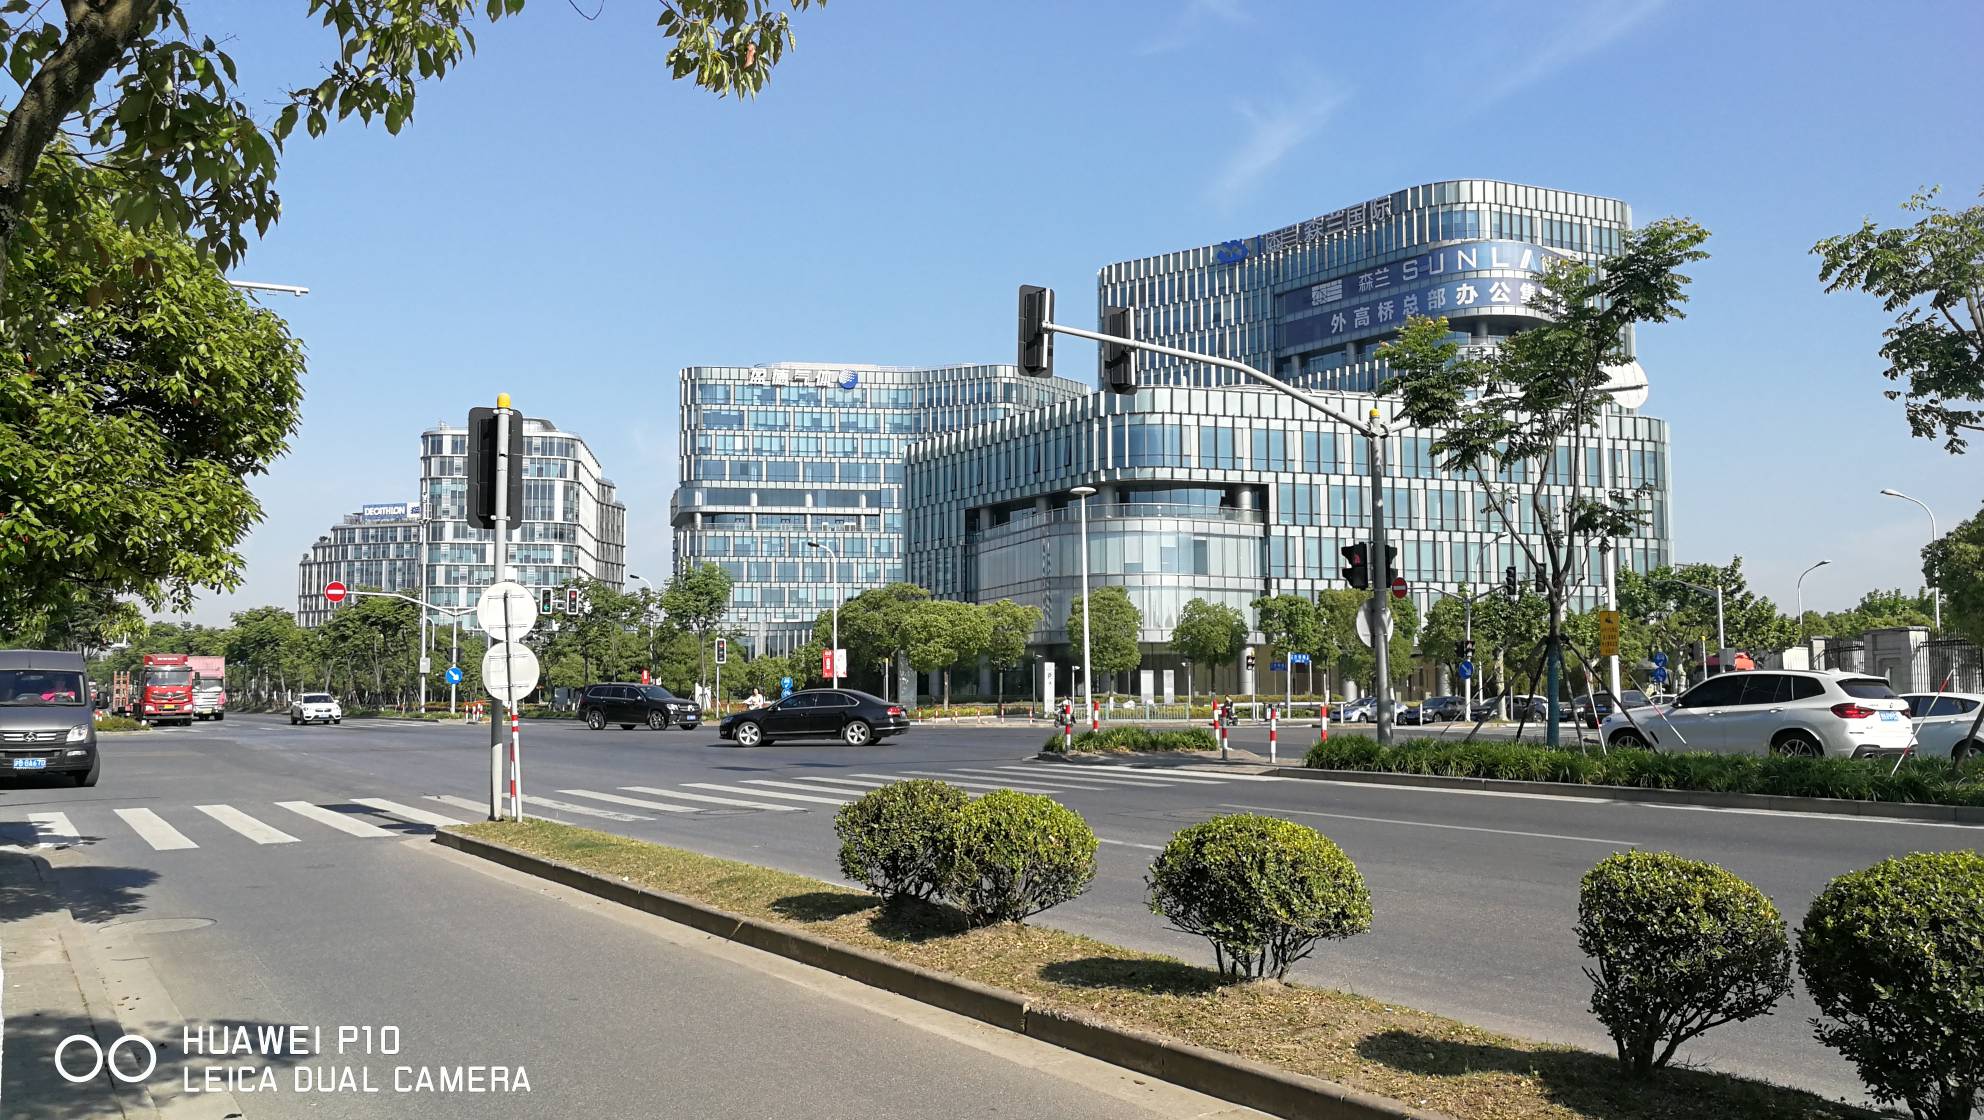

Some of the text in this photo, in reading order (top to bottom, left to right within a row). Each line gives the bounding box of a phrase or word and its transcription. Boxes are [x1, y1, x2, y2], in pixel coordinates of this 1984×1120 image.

[1304, 195, 1392, 243] 森兰国际
[1359, 267, 1391, 292] 森兰
[364, 506, 405, 515] DECATHLON
